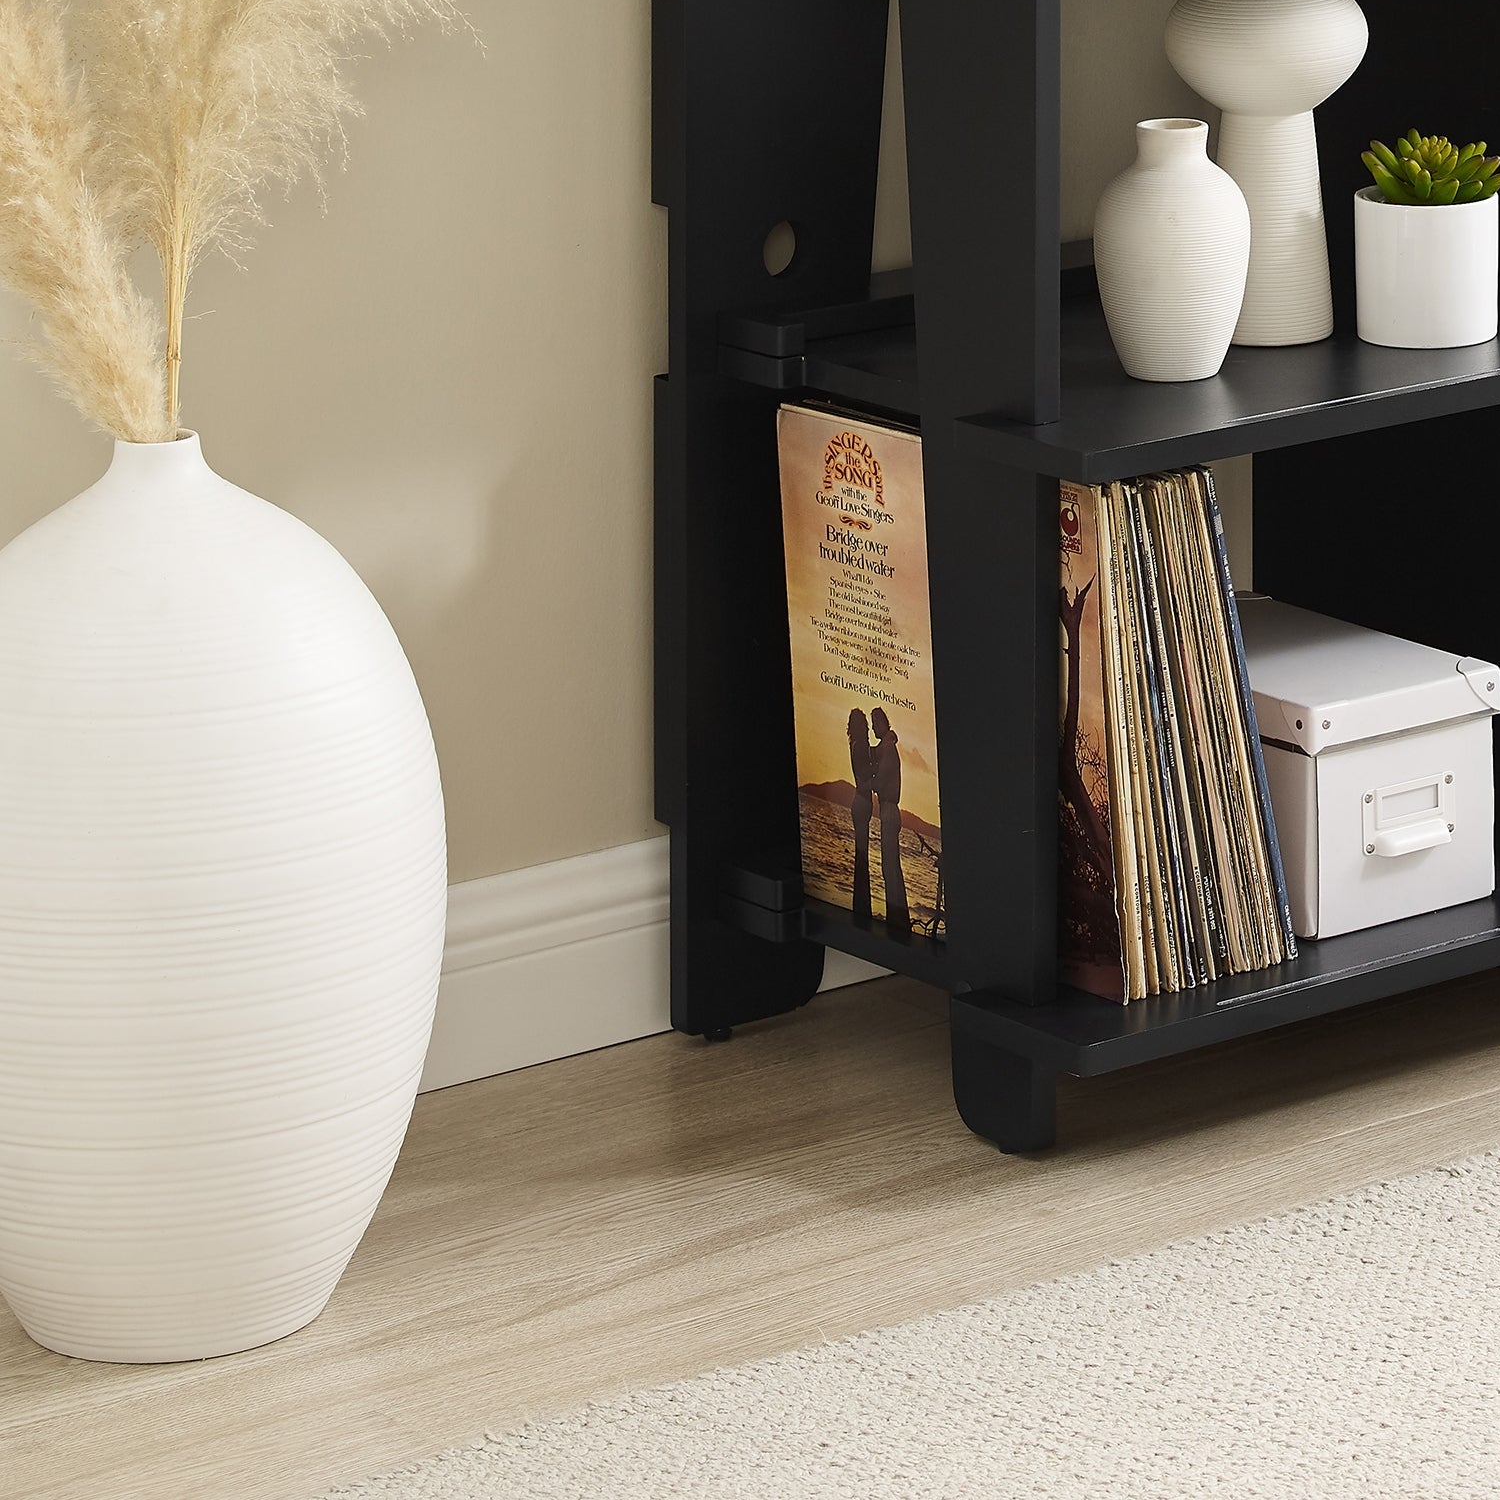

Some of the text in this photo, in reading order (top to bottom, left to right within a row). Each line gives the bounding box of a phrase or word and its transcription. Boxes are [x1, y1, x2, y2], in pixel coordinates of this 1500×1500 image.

[823, 432, 884, 506] the SINGERS and
[834, 463, 872, 488] SONG
[845, 451, 860, 469] the
[815, 490, 894, 524] Geoff Love Singers
[841, 486, 867, 501] with the
[826, 524, 888, 557] Bridge over
[819, 542, 895, 578] troubled water
[829, 575, 886, 600] Spanish eyes She
[866, 576, 874, 586] do
[827, 597, 891, 626] The most beautiful girl
[828, 586, 841, 598] The
[841, 591, 850, 601] old
[850, 593, 879, 610] fashioned
[809, 615, 819, 626] Tie
[823, 620, 840, 634] yellow
[840, 625, 859, 639] ribbon
[860, 630, 877, 645] round
[877, 636, 887, 647] the
[896, 643, 908, 654] oak
[908, 647, 920, 658] tree
[824, 608, 897, 639] Bridge over troubled water
[817, 629, 830, 641] The
[849, 640, 863, 651] were
[869, 645, 896, 663] Welcome
[897, 654, 915, 668] home
[823, 642, 838, 656] Don't
[839, 648, 850, 660] stay
[864, 656, 873, 667] too
[874, 658, 887, 672] long
[894, 665, 908, 679] Sing
[840, 659, 891, 684] Portrait of my love
[820, 669, 915, 712] Geoff Love & his Orchestra
[1124, 683, 1132, 714] MANTOVANI
